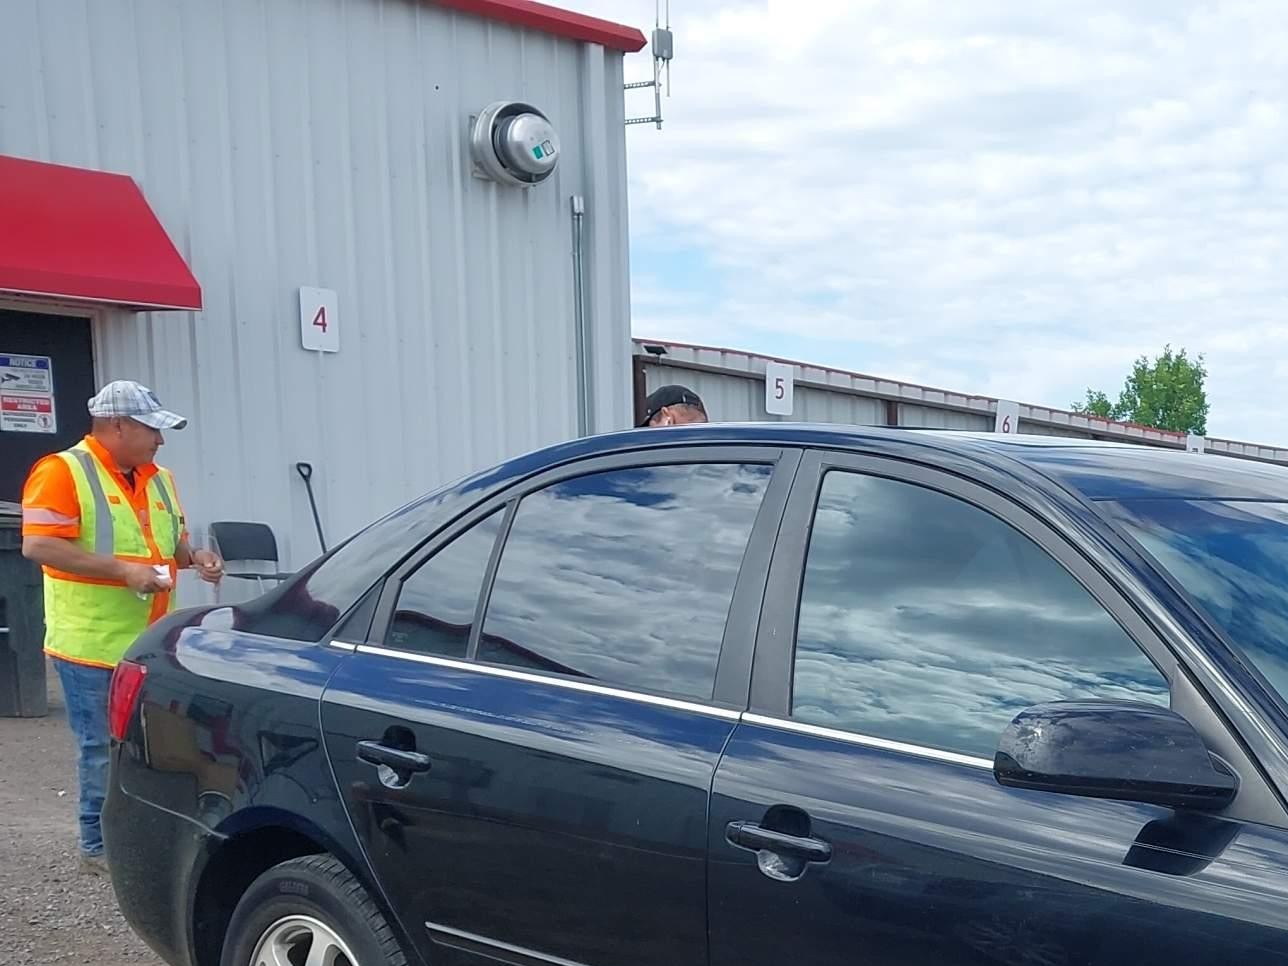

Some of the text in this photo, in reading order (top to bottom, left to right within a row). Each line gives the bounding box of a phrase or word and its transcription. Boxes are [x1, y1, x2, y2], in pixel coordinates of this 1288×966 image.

[313, 306, 327, 333] 4
[9, 357, 36, 368] NOTICE
[775, 377, 785, 400] 5
[1002, 415, 1010, 433] 6
